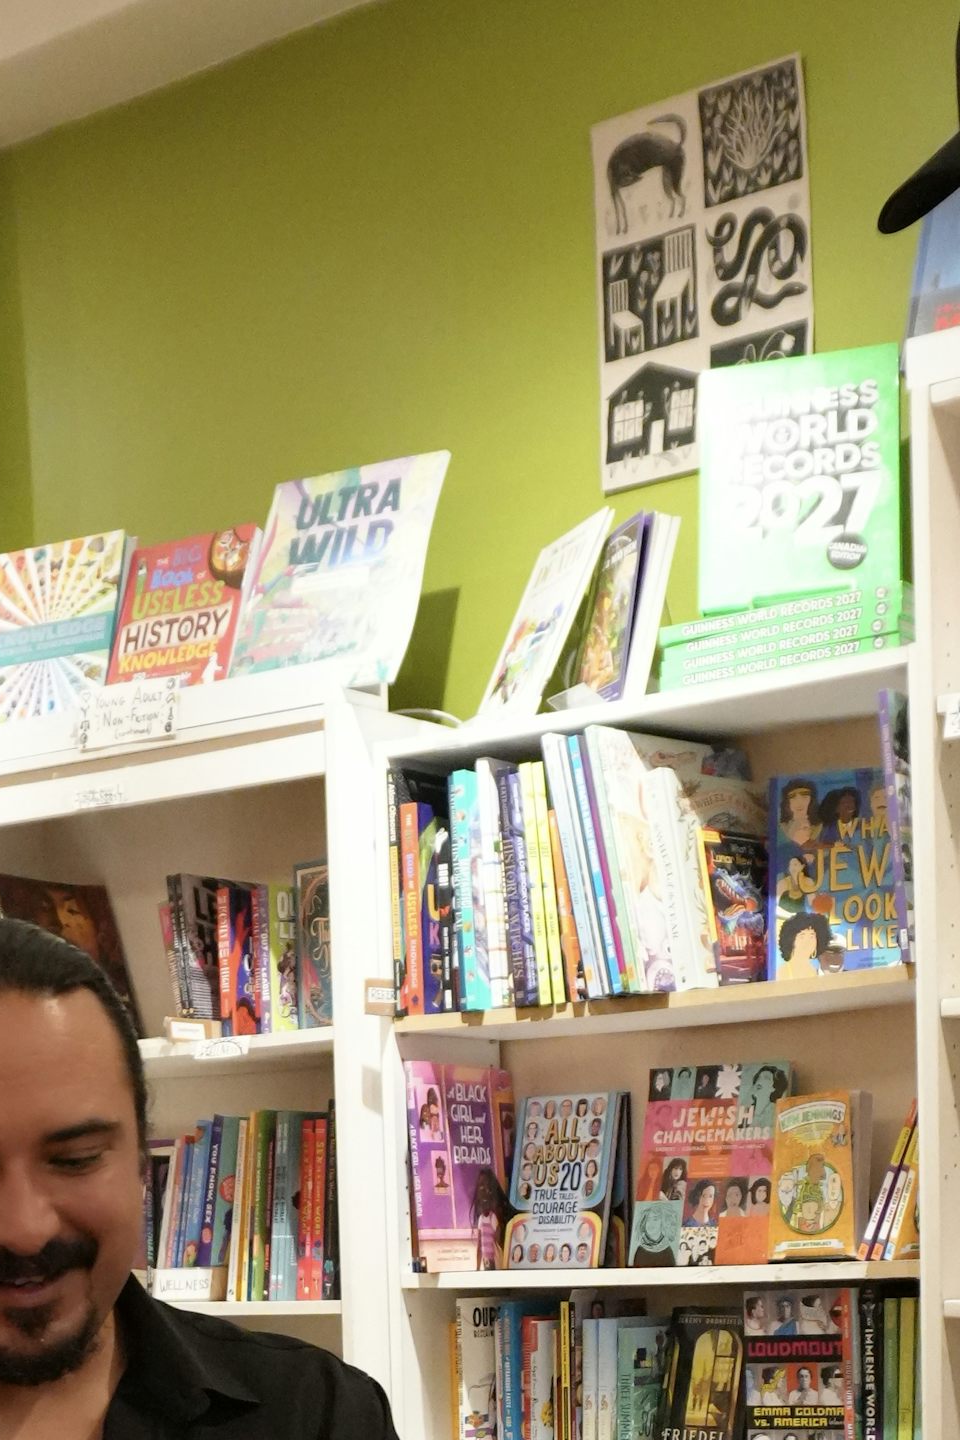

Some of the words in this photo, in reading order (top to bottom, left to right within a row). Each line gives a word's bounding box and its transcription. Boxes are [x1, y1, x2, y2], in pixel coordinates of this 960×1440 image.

[740, 379, 878, 426] UINNESS
[738, 408, 878, 454] WORLD
[296, 477, 402, 530] ULTRA
[737, 469, 881, 534] 2027
[289, 519, 394, 566] WILD
[132, 580, 225, 620] USELESS
[682, 611, 735, 636] GUINNESS
[737, 605, 777, 624] WORLD
[780, 597, 832, 618] RECORDS
[834, 591, 861, 605] 2027
[123, 610, 228, 653] HISTORY
[686, 629, 737, 651] GUINNESS
[740, 622, 779, 640] WORLD
[782, 614, 834, 634] RECORDS
[836, 607, 862, 621] 2027
[118, 640, 218, 675] KNOWLEDGE
[682, 646, 735, 669] GUINNESS
[737, 640, 776, 658] WORLD
[779, 631, 830, 651] RECORDS
[832, 624, 859, 639] 2027
[681, 662, 735, 686] GUINNESS
[737, 657, 777, 675] WORLD
[780, 648, 831, 668] RECORDS
[834, 641, 860, 656] 2027
[387, 783, 395, 805] Atlas
[388, 805, 396, 841] Obscura
[515, 836, 524, 858] ATLAS
[405, 853, 414, 877] BOOK
[450, 843, 460, 886] HISTORY
[502, 837, 518, 898] HISTORY
[517, 860, 526, 871] OF
[799, 843, 890, 894] JEW
[518, 871, 528, 903] SPOOKY
[407, 891, 418, 936] USELESS
[521, 904, 531, 933] PLACES
[667, 901, 681, 939] YEAR
[828, 893, 898, 925] LOOK
[508, 914, 524, 978] WITCHES
[846, 923, 898, 952] LIKE
[409, 939, 418, 988] KNOWLEDGE
[456, 1083, 487, 1103] BLACK
[451, 1104, 474, 1123] GIRL
[672, 1104, 755, 1129] JEWISH
[409, 1129, 417, 1150] BLACK
[460, 1126, 483, 1145] HER
[544, 1118, 581, 1144] ALL
[653, 1125, 771, 1145] CHANGEMAKERS
[210, 1143, 219, 1163] YOU
[315, 1141, 323, 1165] SEX
[411, 1151, 419, 1166] GIRL
[453, 1147, 491, 1165] BRAIDS
[533, 1143, 588, 1164] ABOUT
[533, 1164, 560, 1188] US
[559, 1162, 582, 1191] 20
[414, 1191, 423, 1217] BRAIDS
[532, 1201, 578, 1215] COURAGE
[534, 1188, 558, 1201] TRUE
[203, 1203, 212, 1223] SEX
[314, 1205, 322, 1234] WORD
[538, 1214, 577, 1225] DISABILITY
[160, 1279, 209, 1292] WELLNESS
[863, 1328, 875, 1391] IMMENSE
[753, 1406, 791, 1416] EMMA
[773, 1417, 829, 1427] AMERICA
